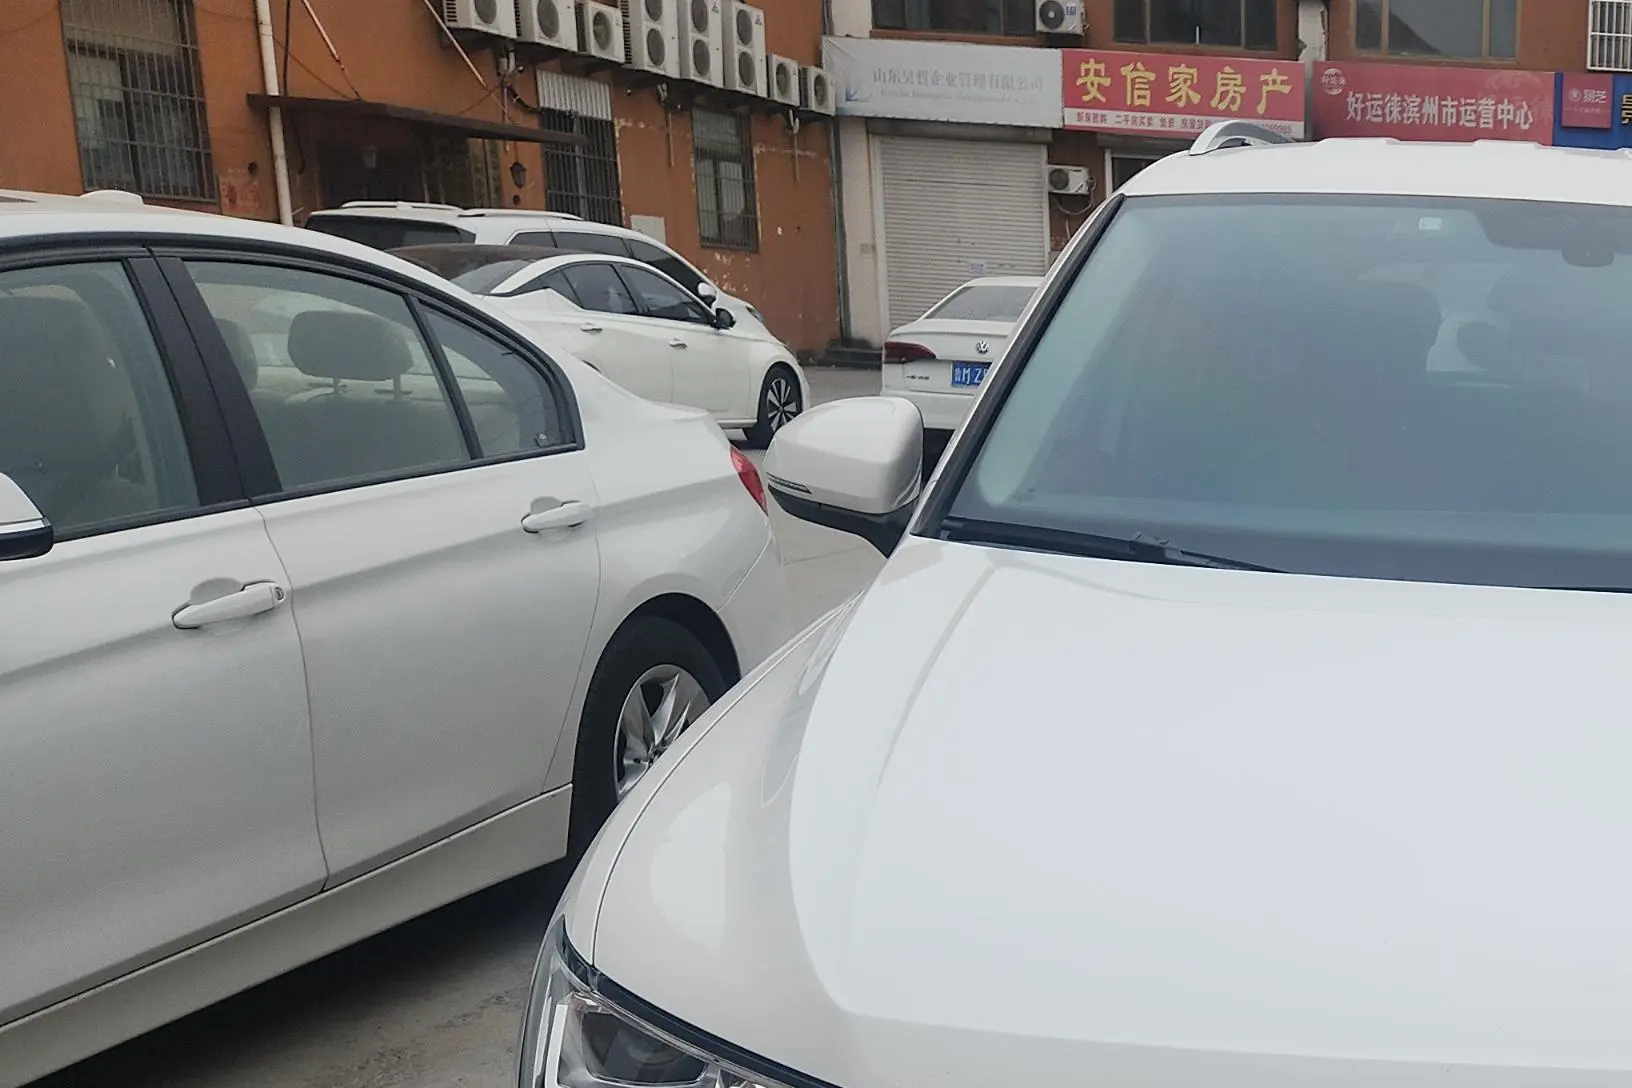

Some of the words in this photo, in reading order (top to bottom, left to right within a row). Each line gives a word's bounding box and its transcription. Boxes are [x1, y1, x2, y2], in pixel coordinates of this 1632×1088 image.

[1076, 58, 1293, 115] 安信家房产
